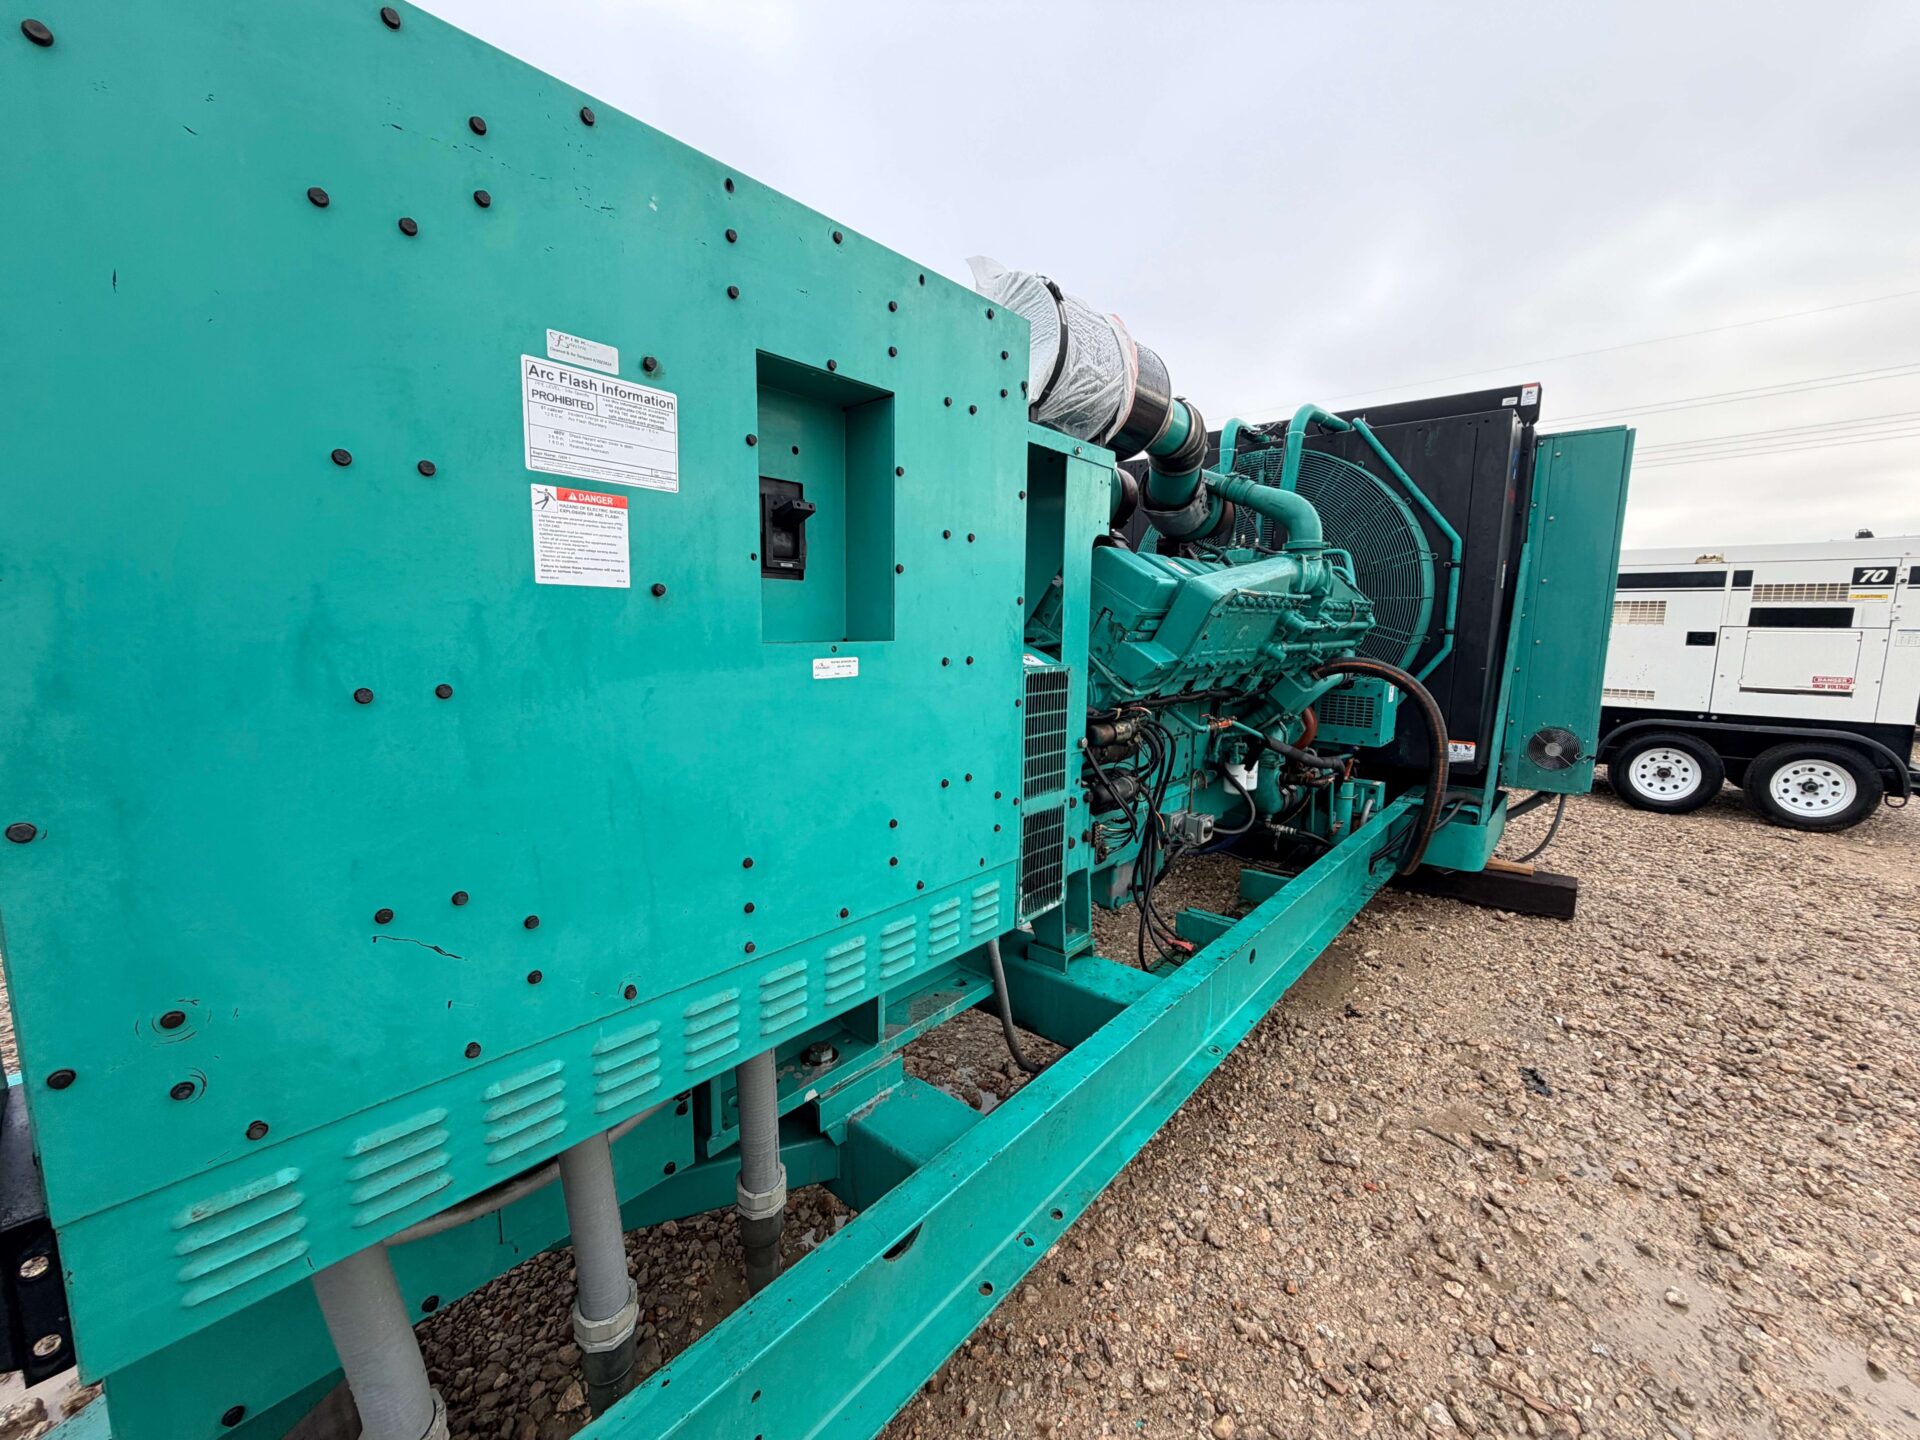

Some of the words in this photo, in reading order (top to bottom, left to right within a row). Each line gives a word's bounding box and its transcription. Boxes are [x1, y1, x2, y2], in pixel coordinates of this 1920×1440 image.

[528, 364, 554, 380] Arc
[559, 372, 597, 391] Flash
[602, 382, 673, 410] Information
[532, 389, 594, 410] PROHIBITED
[579, 494, 613, 505] DANGER
[1860, 570, 1888, 582] 70
